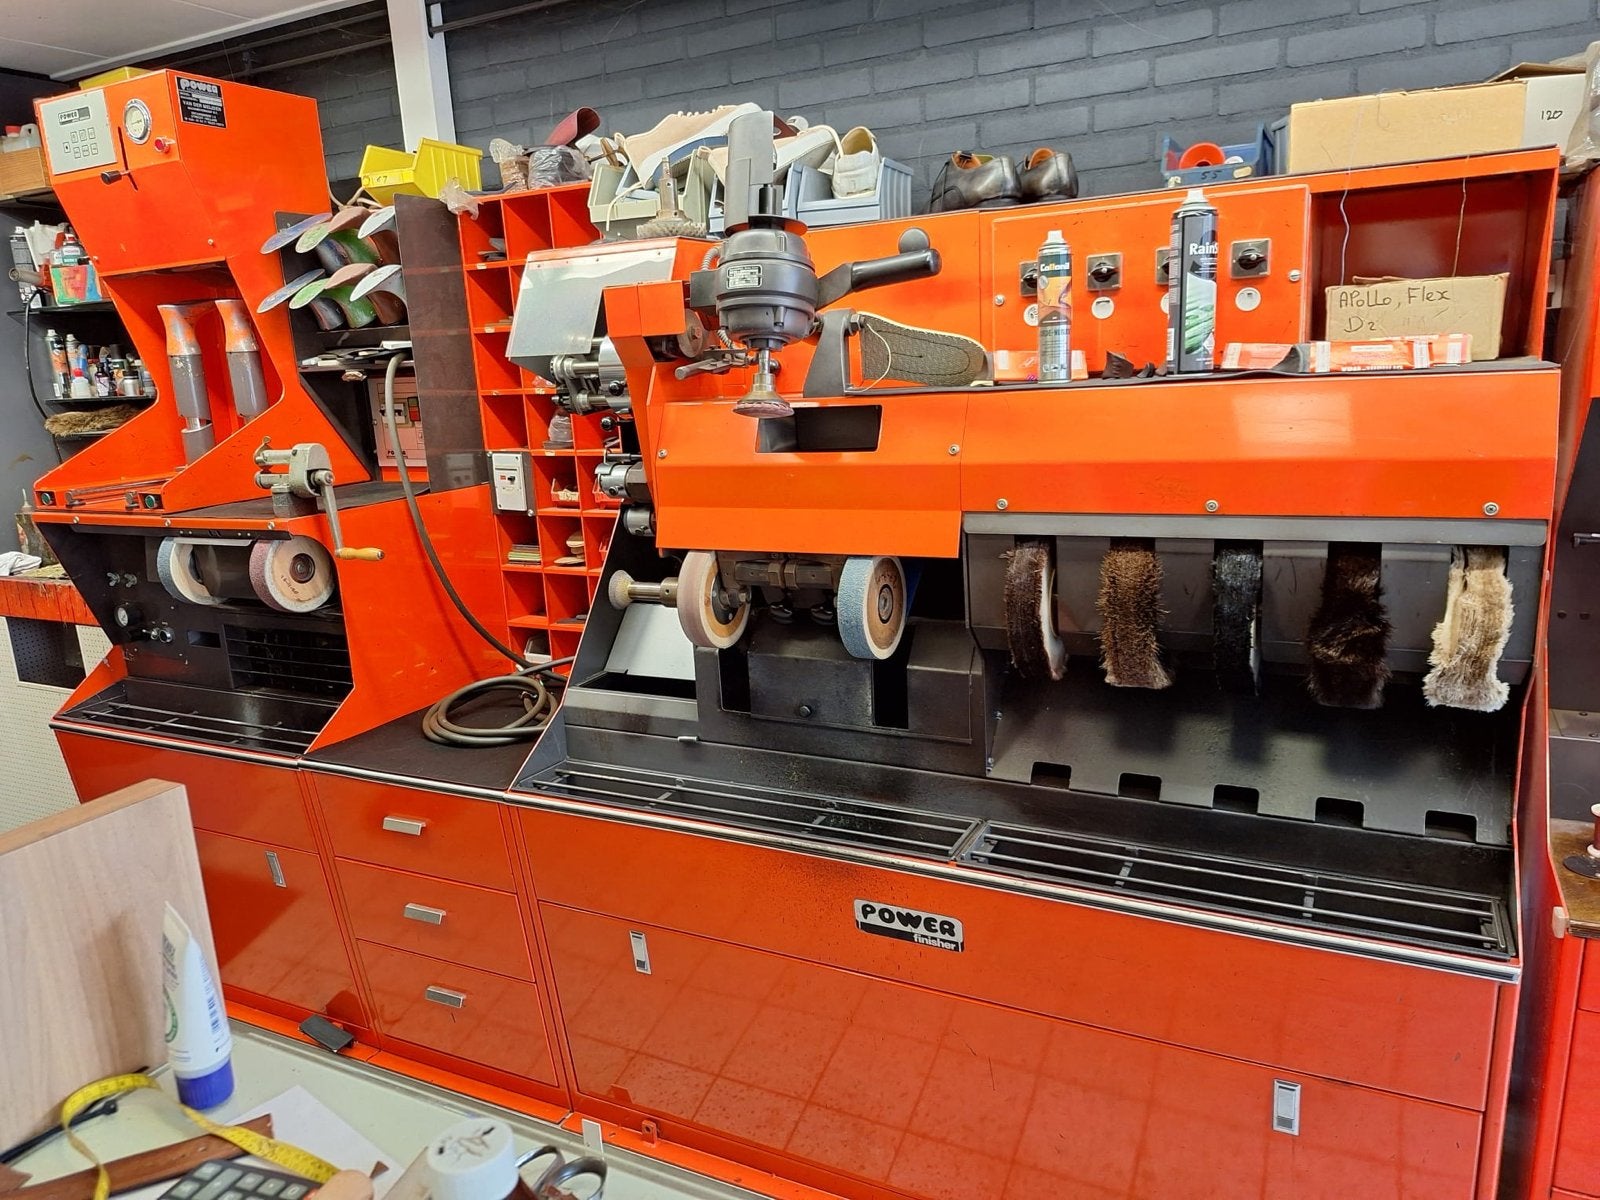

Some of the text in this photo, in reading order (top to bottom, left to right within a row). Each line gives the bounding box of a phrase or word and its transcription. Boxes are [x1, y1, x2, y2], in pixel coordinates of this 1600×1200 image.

[180, 79, 218, 93] POWER
[1541, 110, 1563, 121] 120
[1040, 262, 1070, 272] Collonil
[1407, 286, 1450, 305] Flex
[861, 903, 956, 937] POWER
[912, 933, 957, 951] finisher
